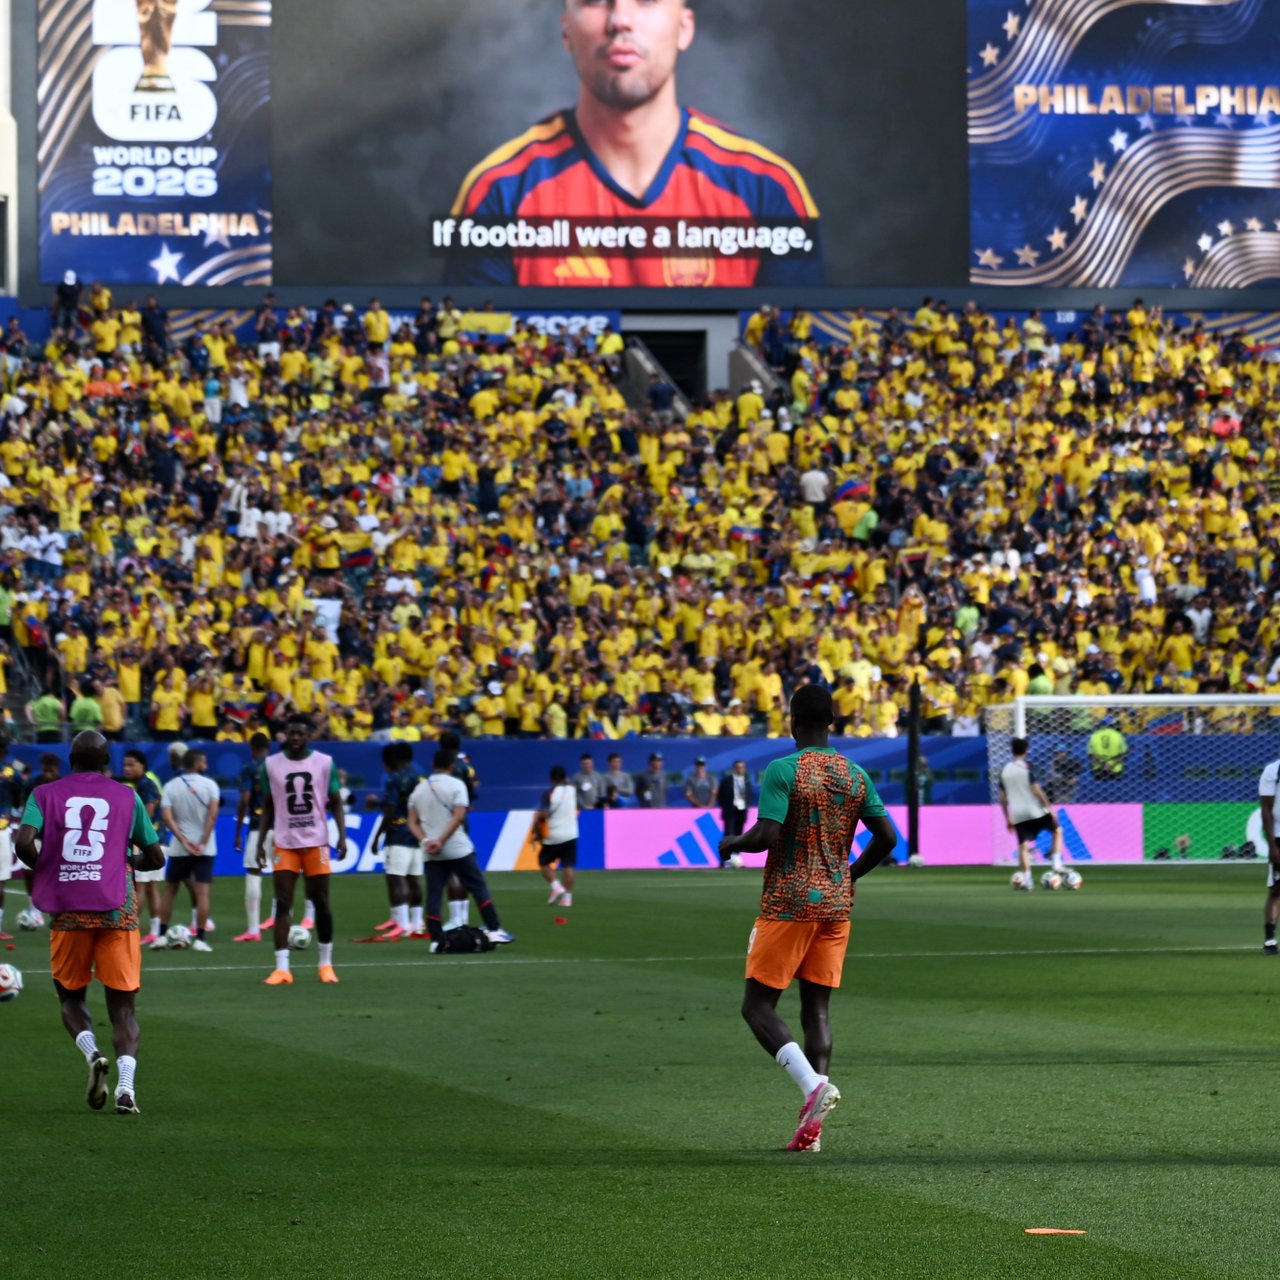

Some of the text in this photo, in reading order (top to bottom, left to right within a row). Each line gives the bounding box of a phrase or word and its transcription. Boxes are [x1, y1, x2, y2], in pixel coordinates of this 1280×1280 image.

[130, 104, 182, 121] FIFA
[93, 146, 218, 166] WORLD CUP
[92, 166, 218, 197] 2026
[51, 211, 259, 236] PHILADELPHIA
[433, 219, 813, 254] If football were a language,
[73, 848, 92, 857] FIFA
[59, 871, 101, 881] 2026
